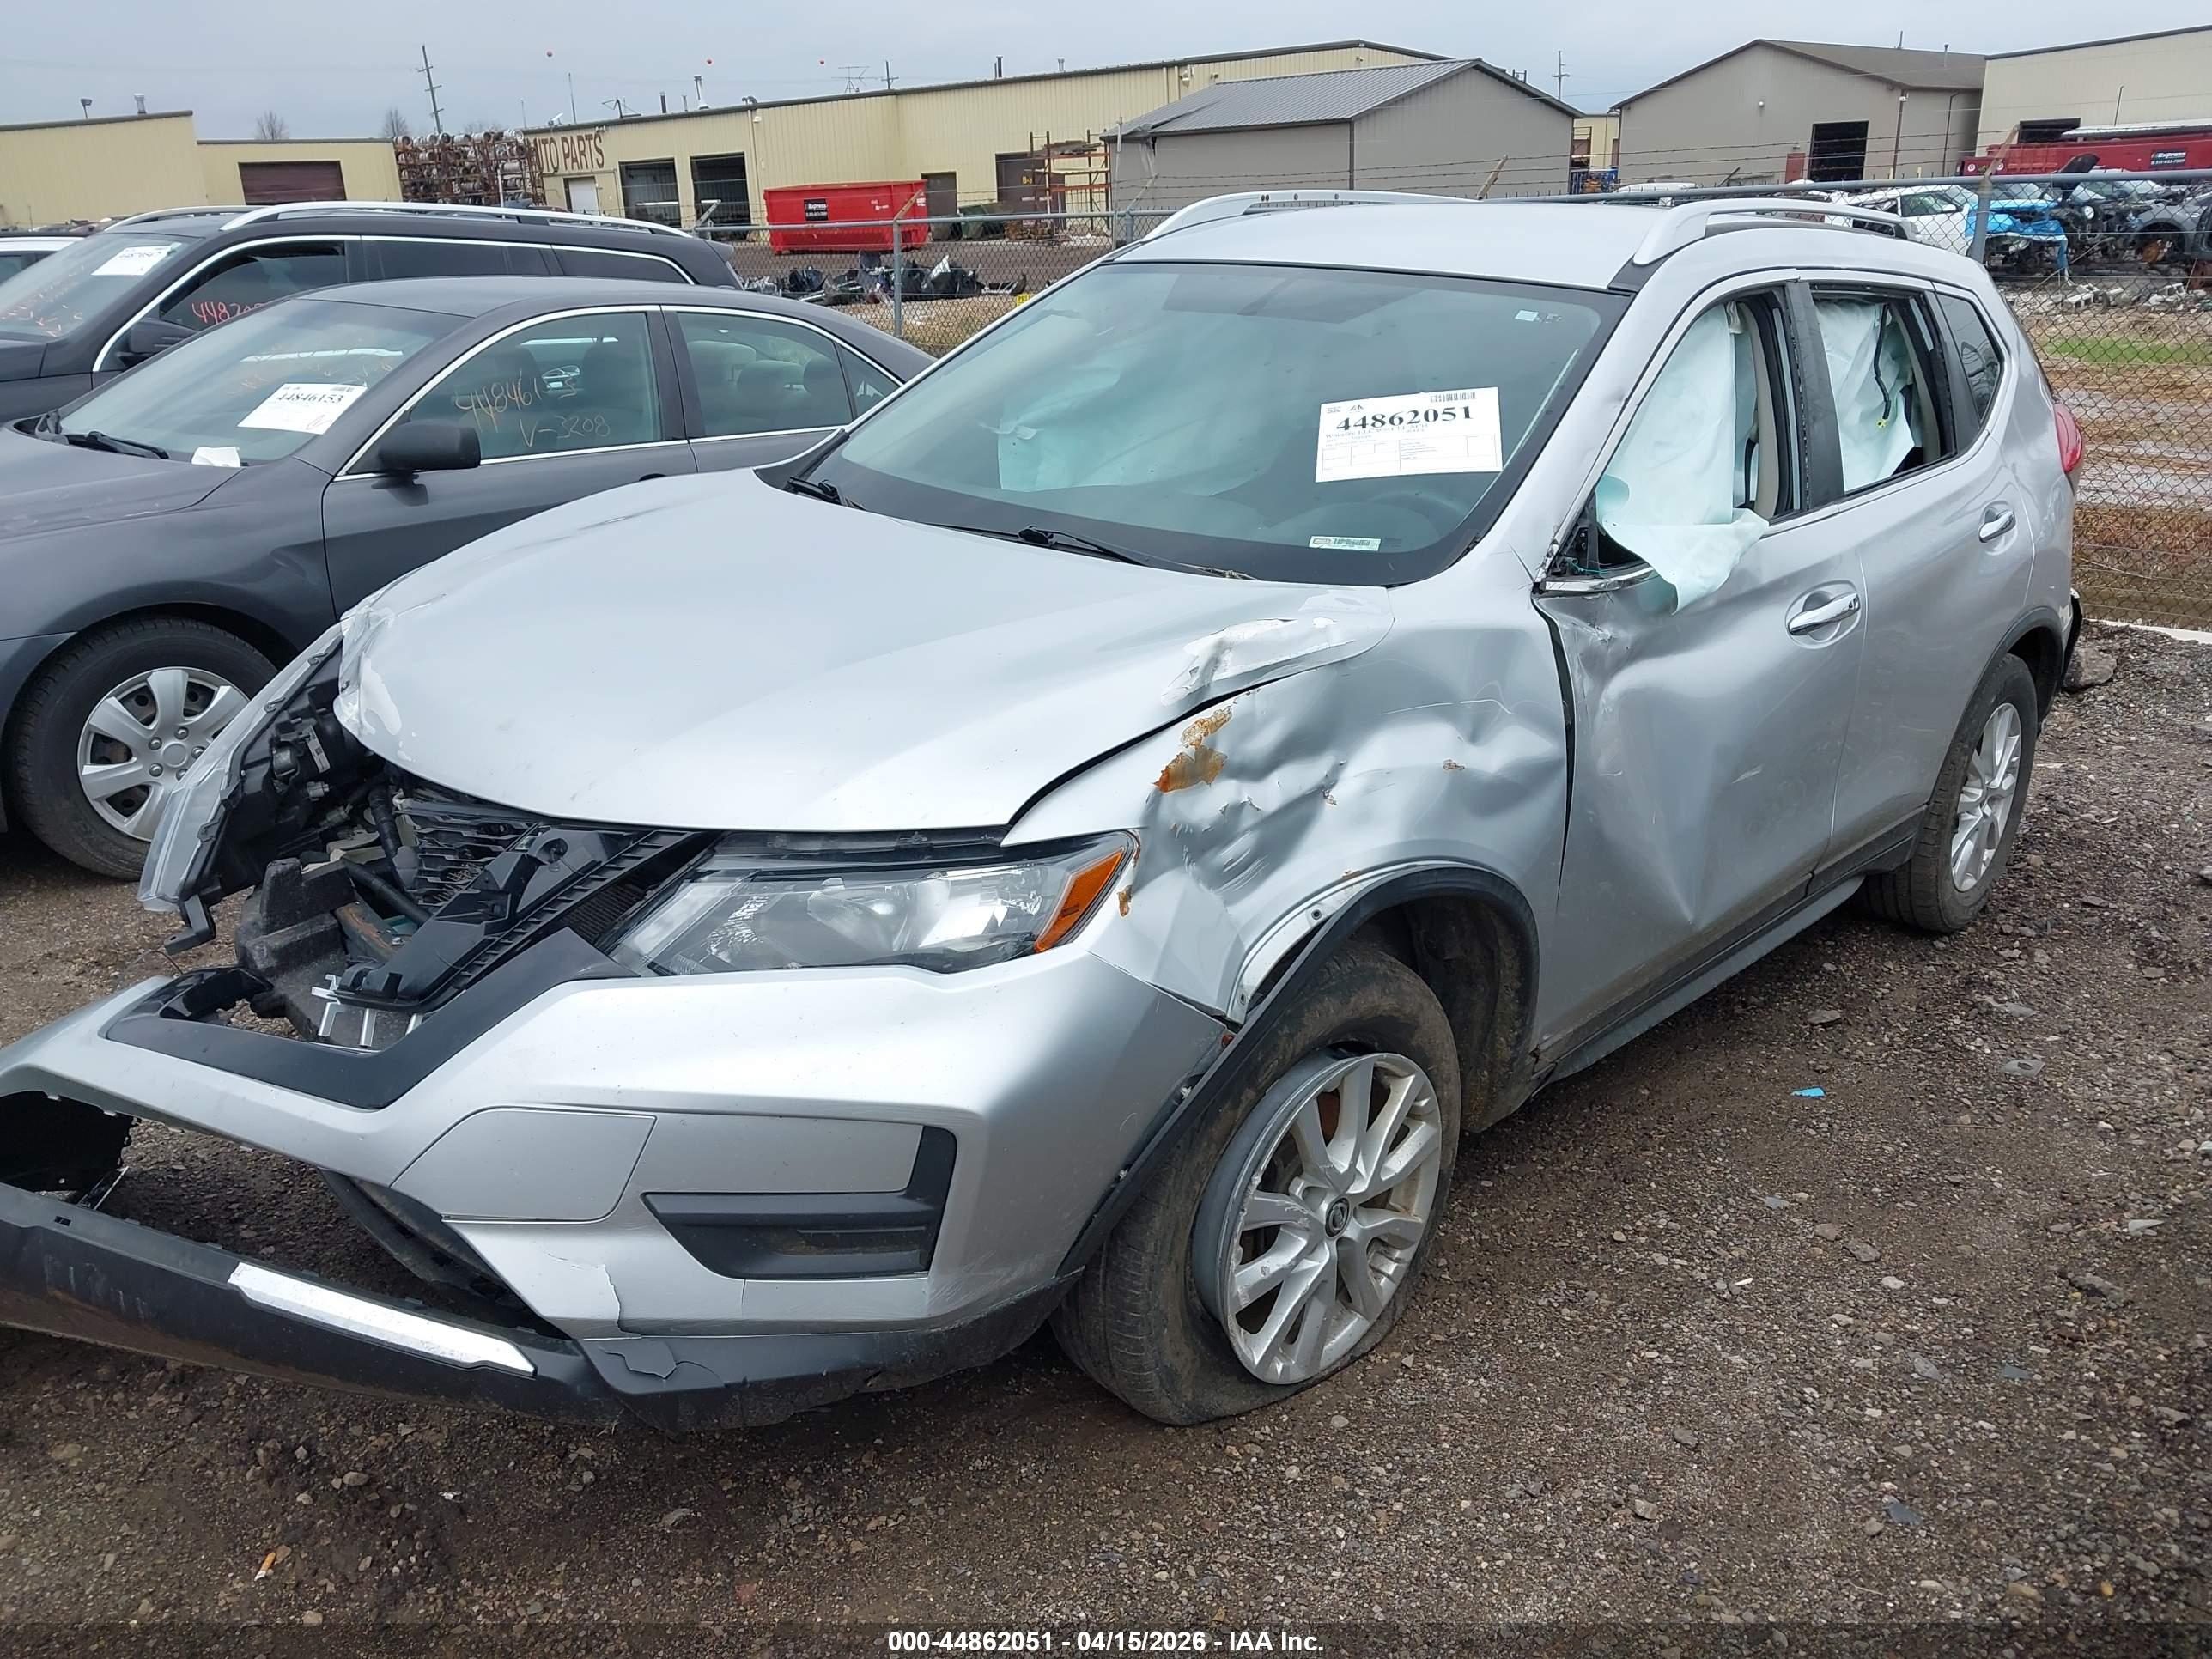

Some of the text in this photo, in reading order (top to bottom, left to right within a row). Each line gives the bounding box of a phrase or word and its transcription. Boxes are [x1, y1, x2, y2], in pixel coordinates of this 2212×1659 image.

[561, 132, 605, 170] PARTS
[276, 393, 345, 404] 44846153
[1336, 405, 1474, 431] 44862051
